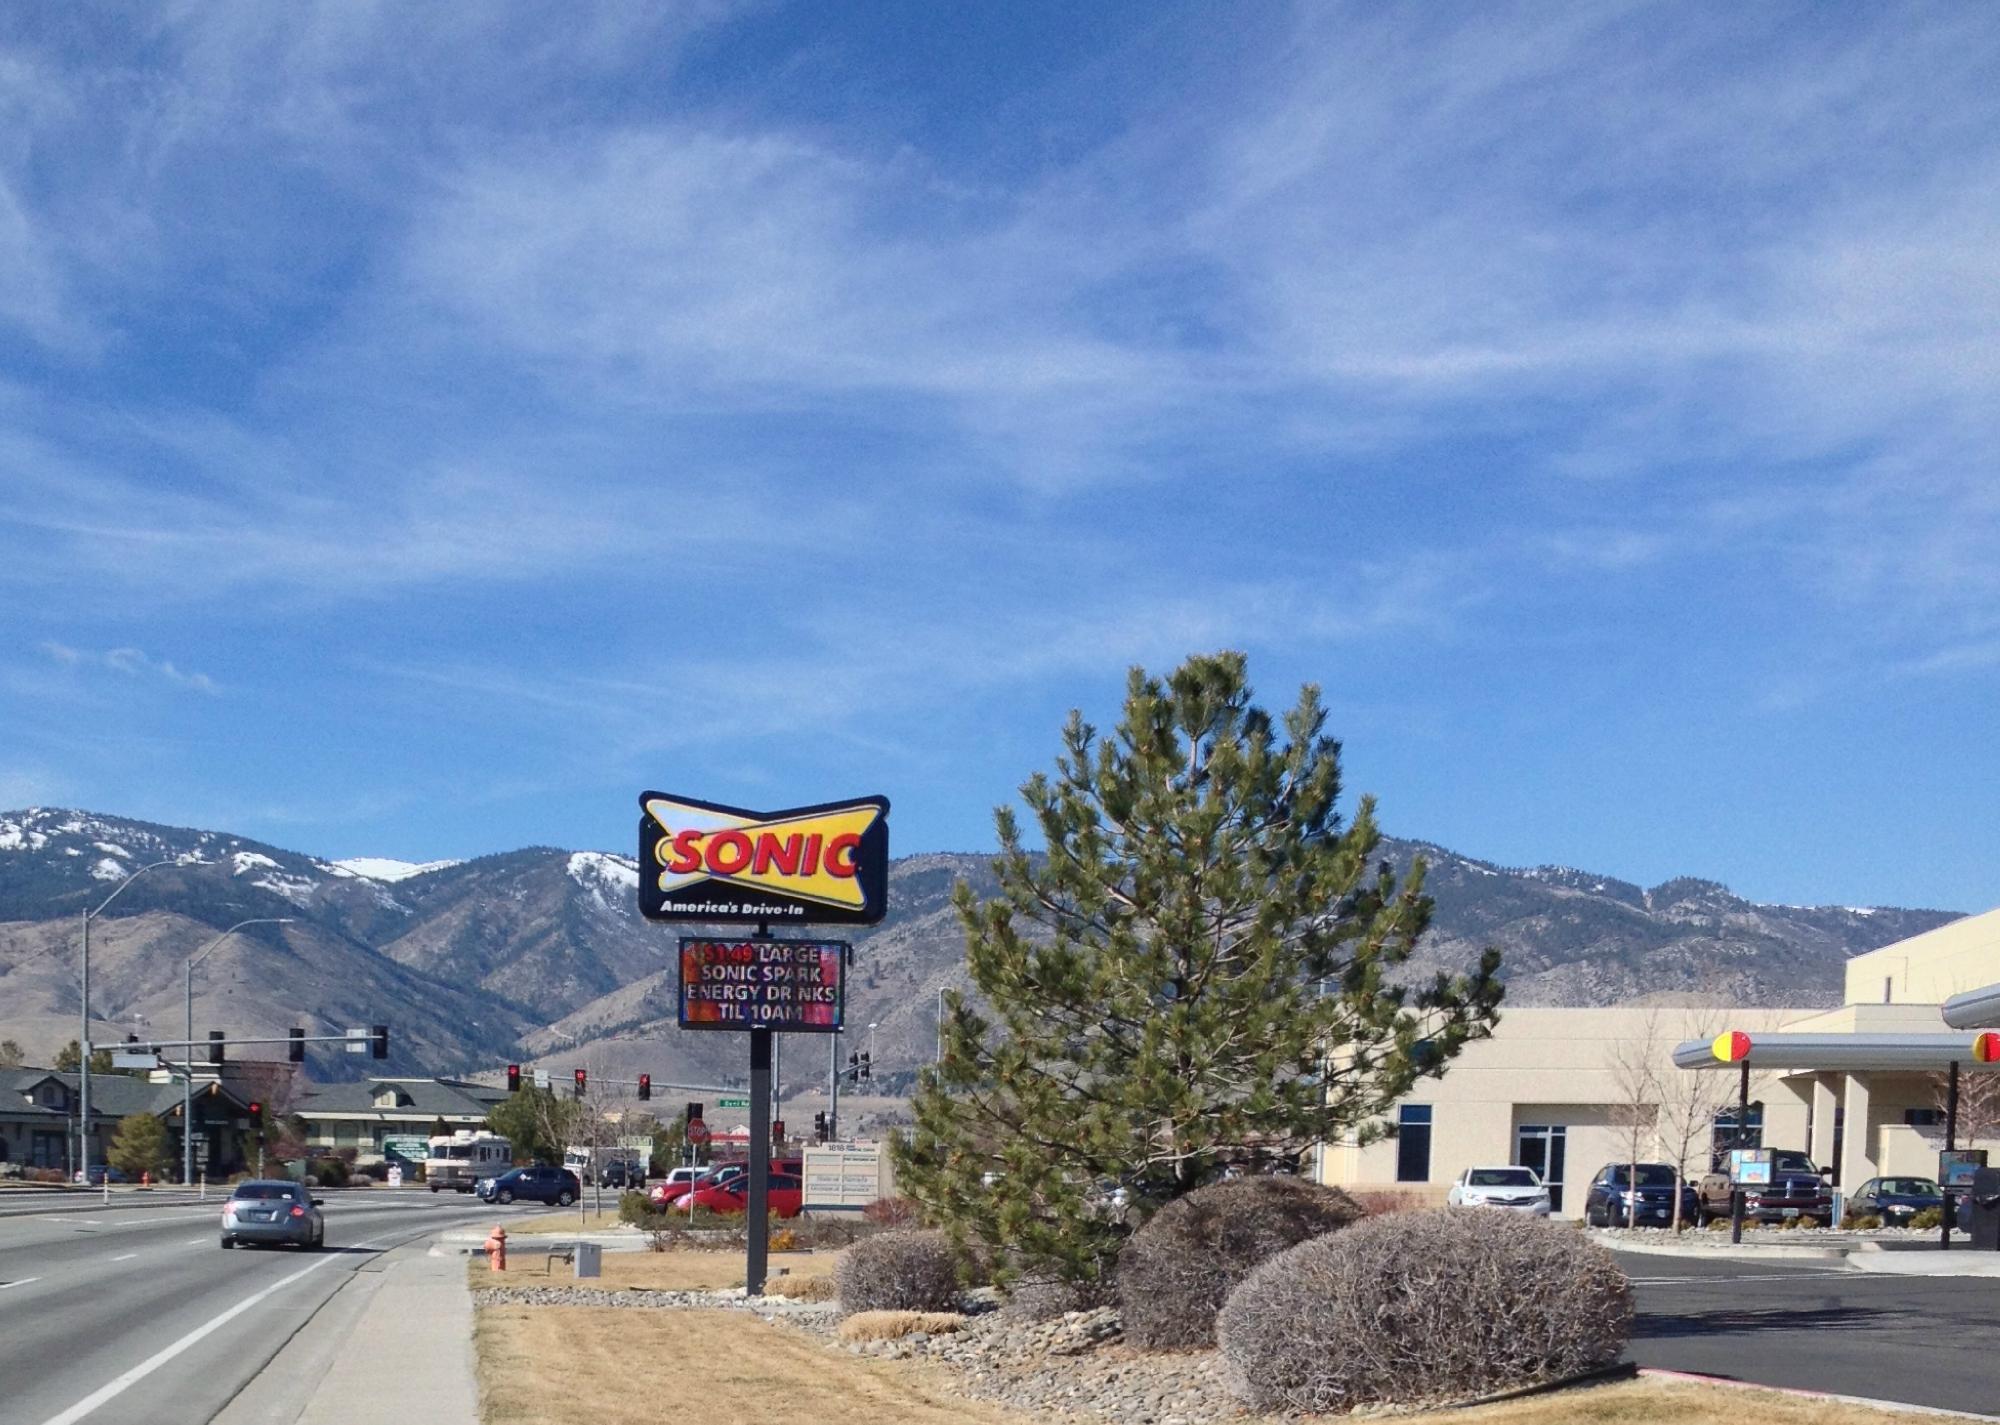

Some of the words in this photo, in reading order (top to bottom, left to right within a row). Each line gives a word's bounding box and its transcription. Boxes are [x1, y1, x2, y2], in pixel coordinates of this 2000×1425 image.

[667, 830, 862, 878] SONIC
[660, 900, 739, 914] America's
[704, 943, 753, 961] $149
[759, 946, 819, 963] LARGE
[701, 965, 758, 981] SONIC
[762, 966, 821, 983] SPARK
[687, 983, 761, 1001] ENERGY
[766, 987, 835, 1003] DRNKS
[718, 1003, 745, 1020] TIL
[751, 1004, 803, 1021] 10AM
[688, 1126, 706, 1138] STOP
